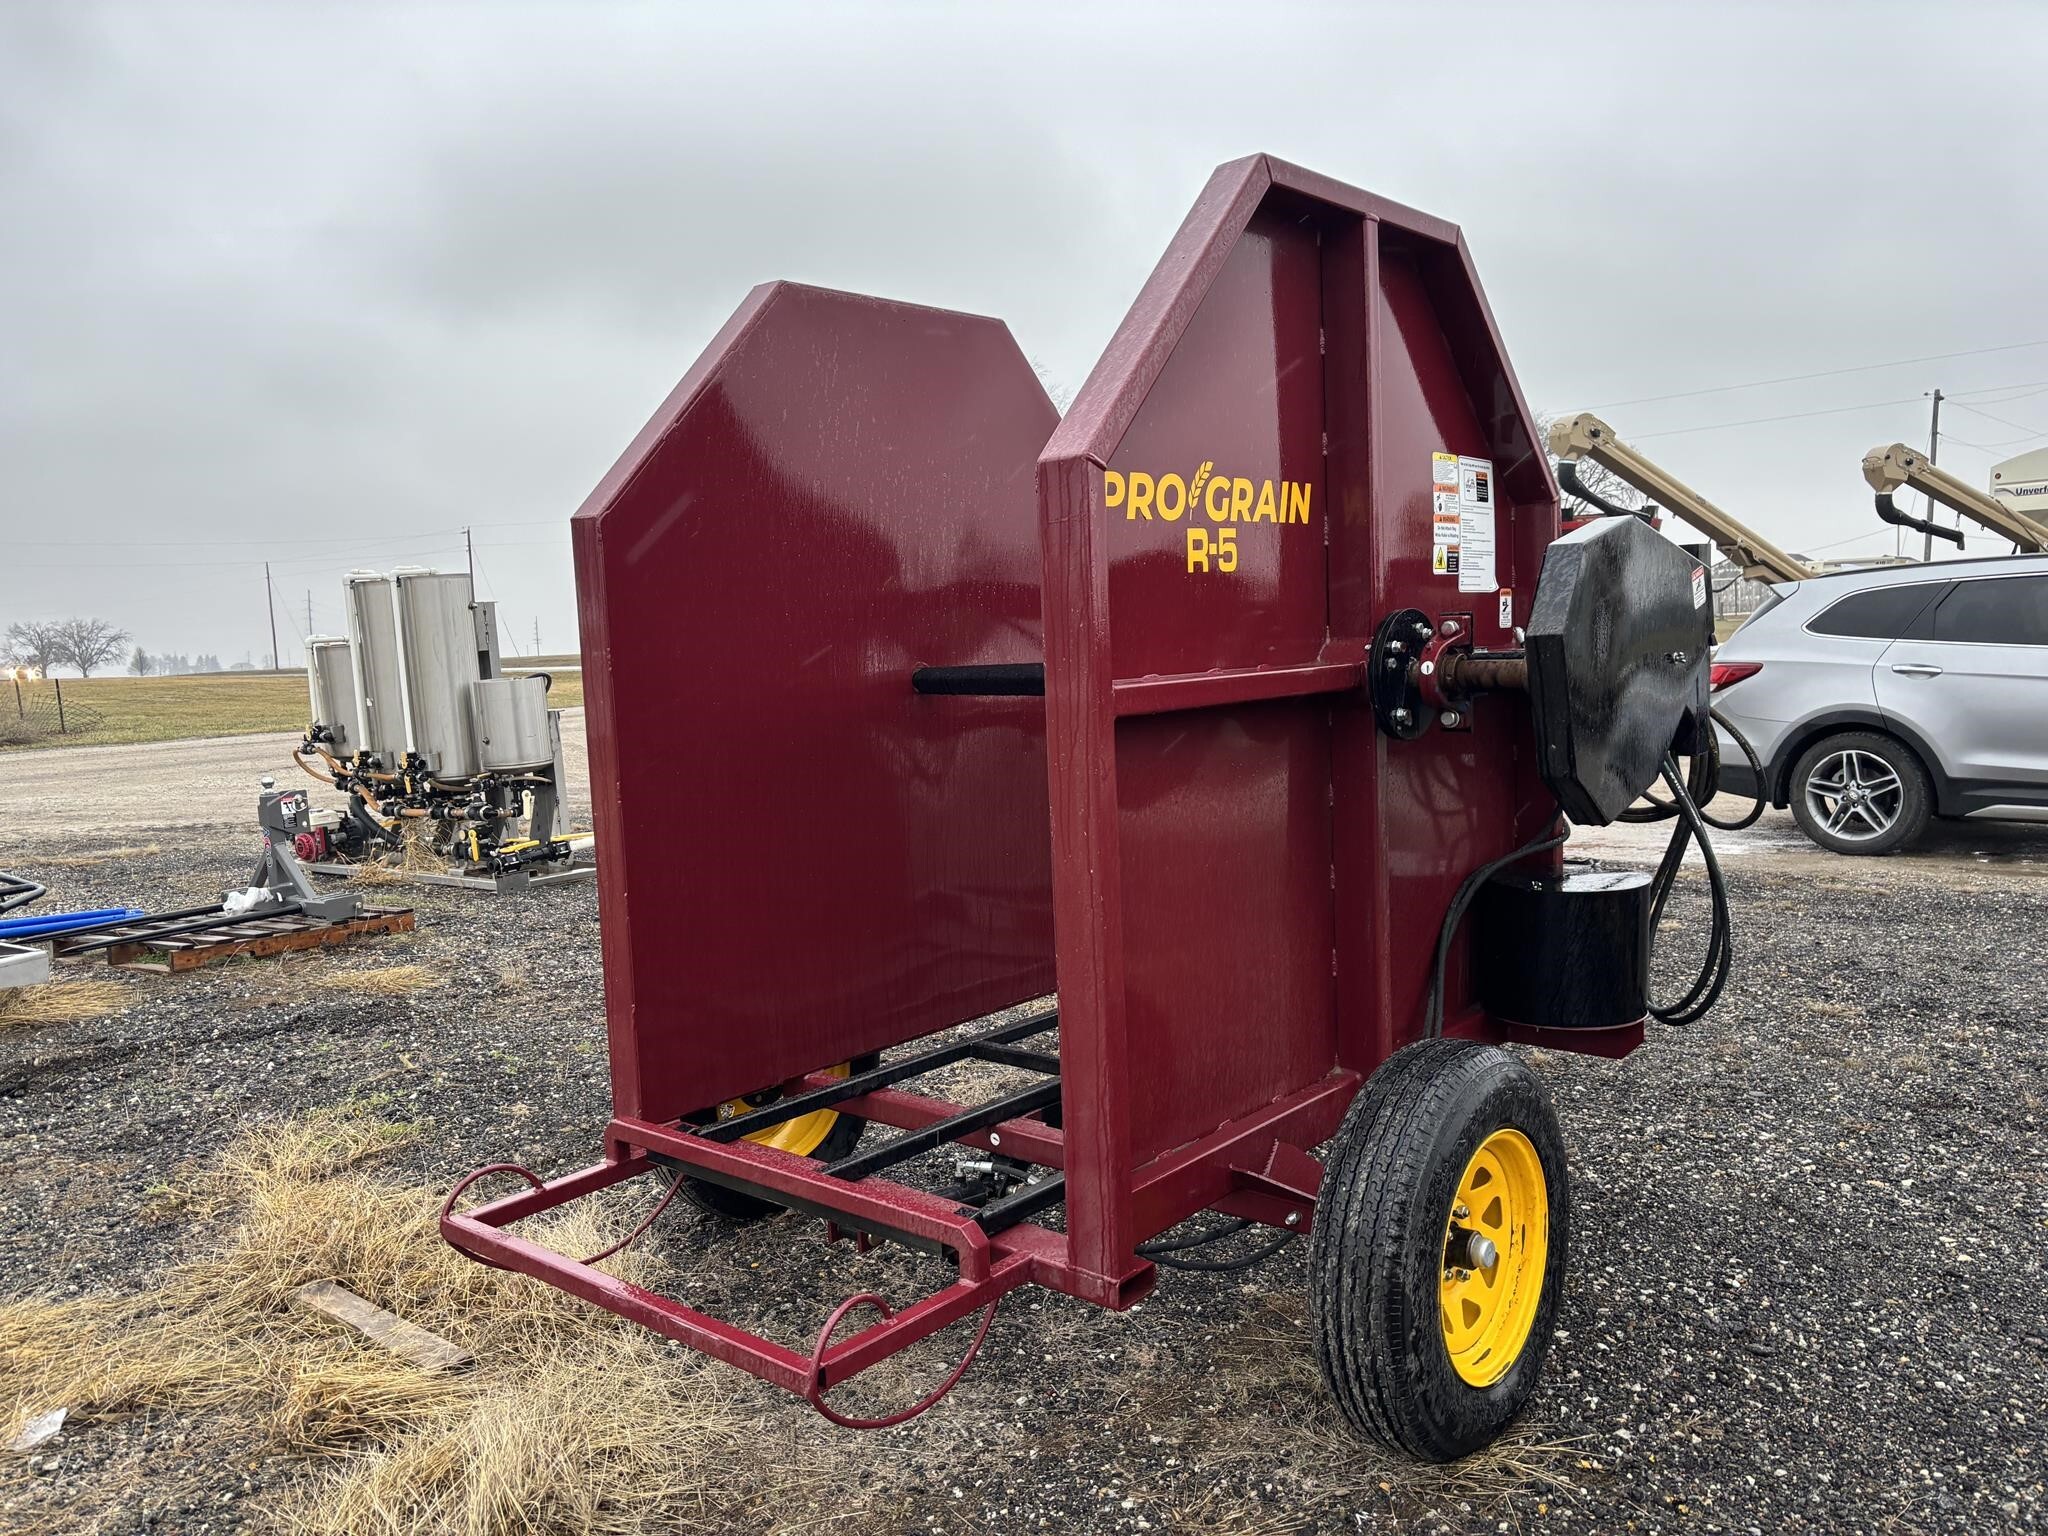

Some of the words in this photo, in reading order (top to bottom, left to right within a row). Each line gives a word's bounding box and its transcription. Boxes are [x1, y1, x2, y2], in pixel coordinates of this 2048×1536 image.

[1105, 471, 1187, 521] PRO
[1205, 476, 1312, 524] GRAIN
[2016, 485, 2048, 496] Unverf
[1187, 527, 1238, 573] R-5
